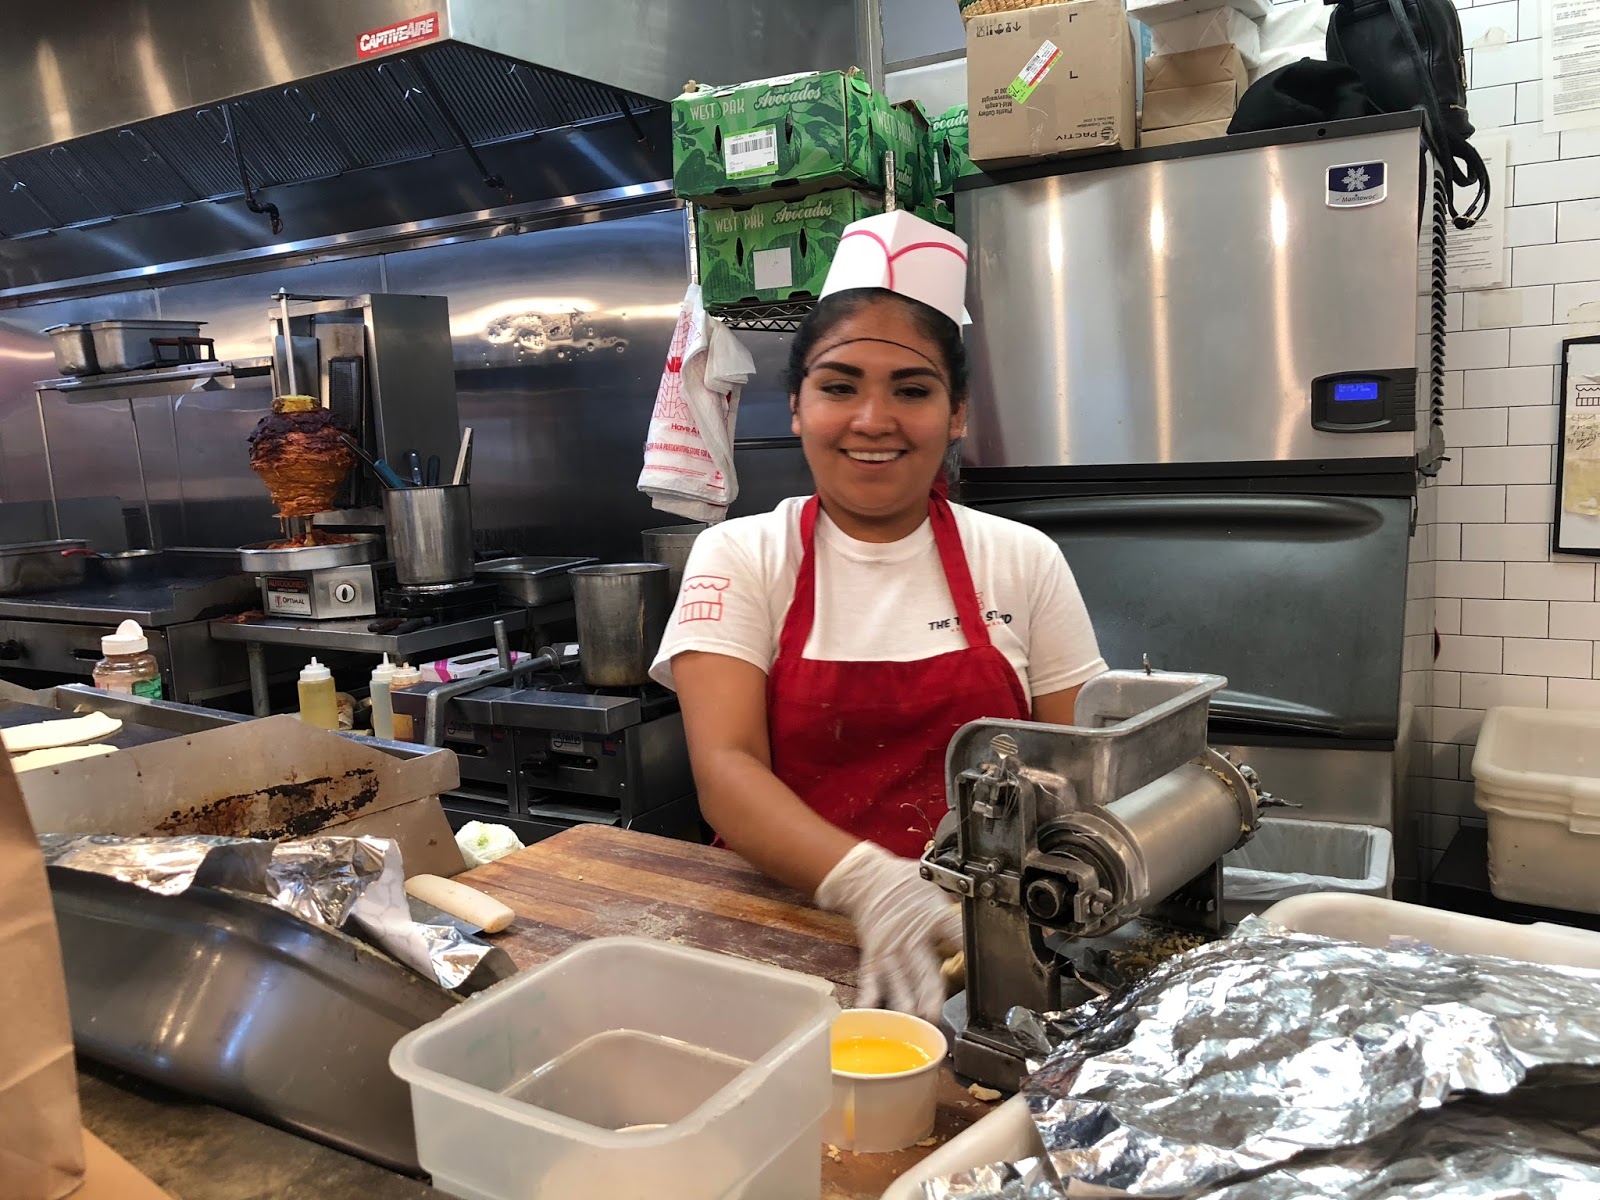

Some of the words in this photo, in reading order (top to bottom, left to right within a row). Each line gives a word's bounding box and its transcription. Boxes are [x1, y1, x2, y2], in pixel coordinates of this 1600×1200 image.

[360, 18, 434, 51] CAPTIVEAIRE
[690, 103, 716, 120] WEST
[722, 98, 745, 116] PAK
[754, 82, 822, 110] Avocados
[985, 101, 1012, 109] Mid-Length
[932, 110, 968, 132] ocado
[1055, 131, 1097, 140] PACTIV
[1342, 194, 1376, 203] Manitowoc
[715, 216, 738, 233] WEST
[744, 212, 764, 230] PAK
[772, 201, 833, 225] Avocados
[671, 423, 690, 433] Have
[663, 443, 689, 453] PARTICIPATING
[689, 447, 700, 456] STORE
[928, 619, 950, 630] THE
[986, 610, 1012, 624] STD
